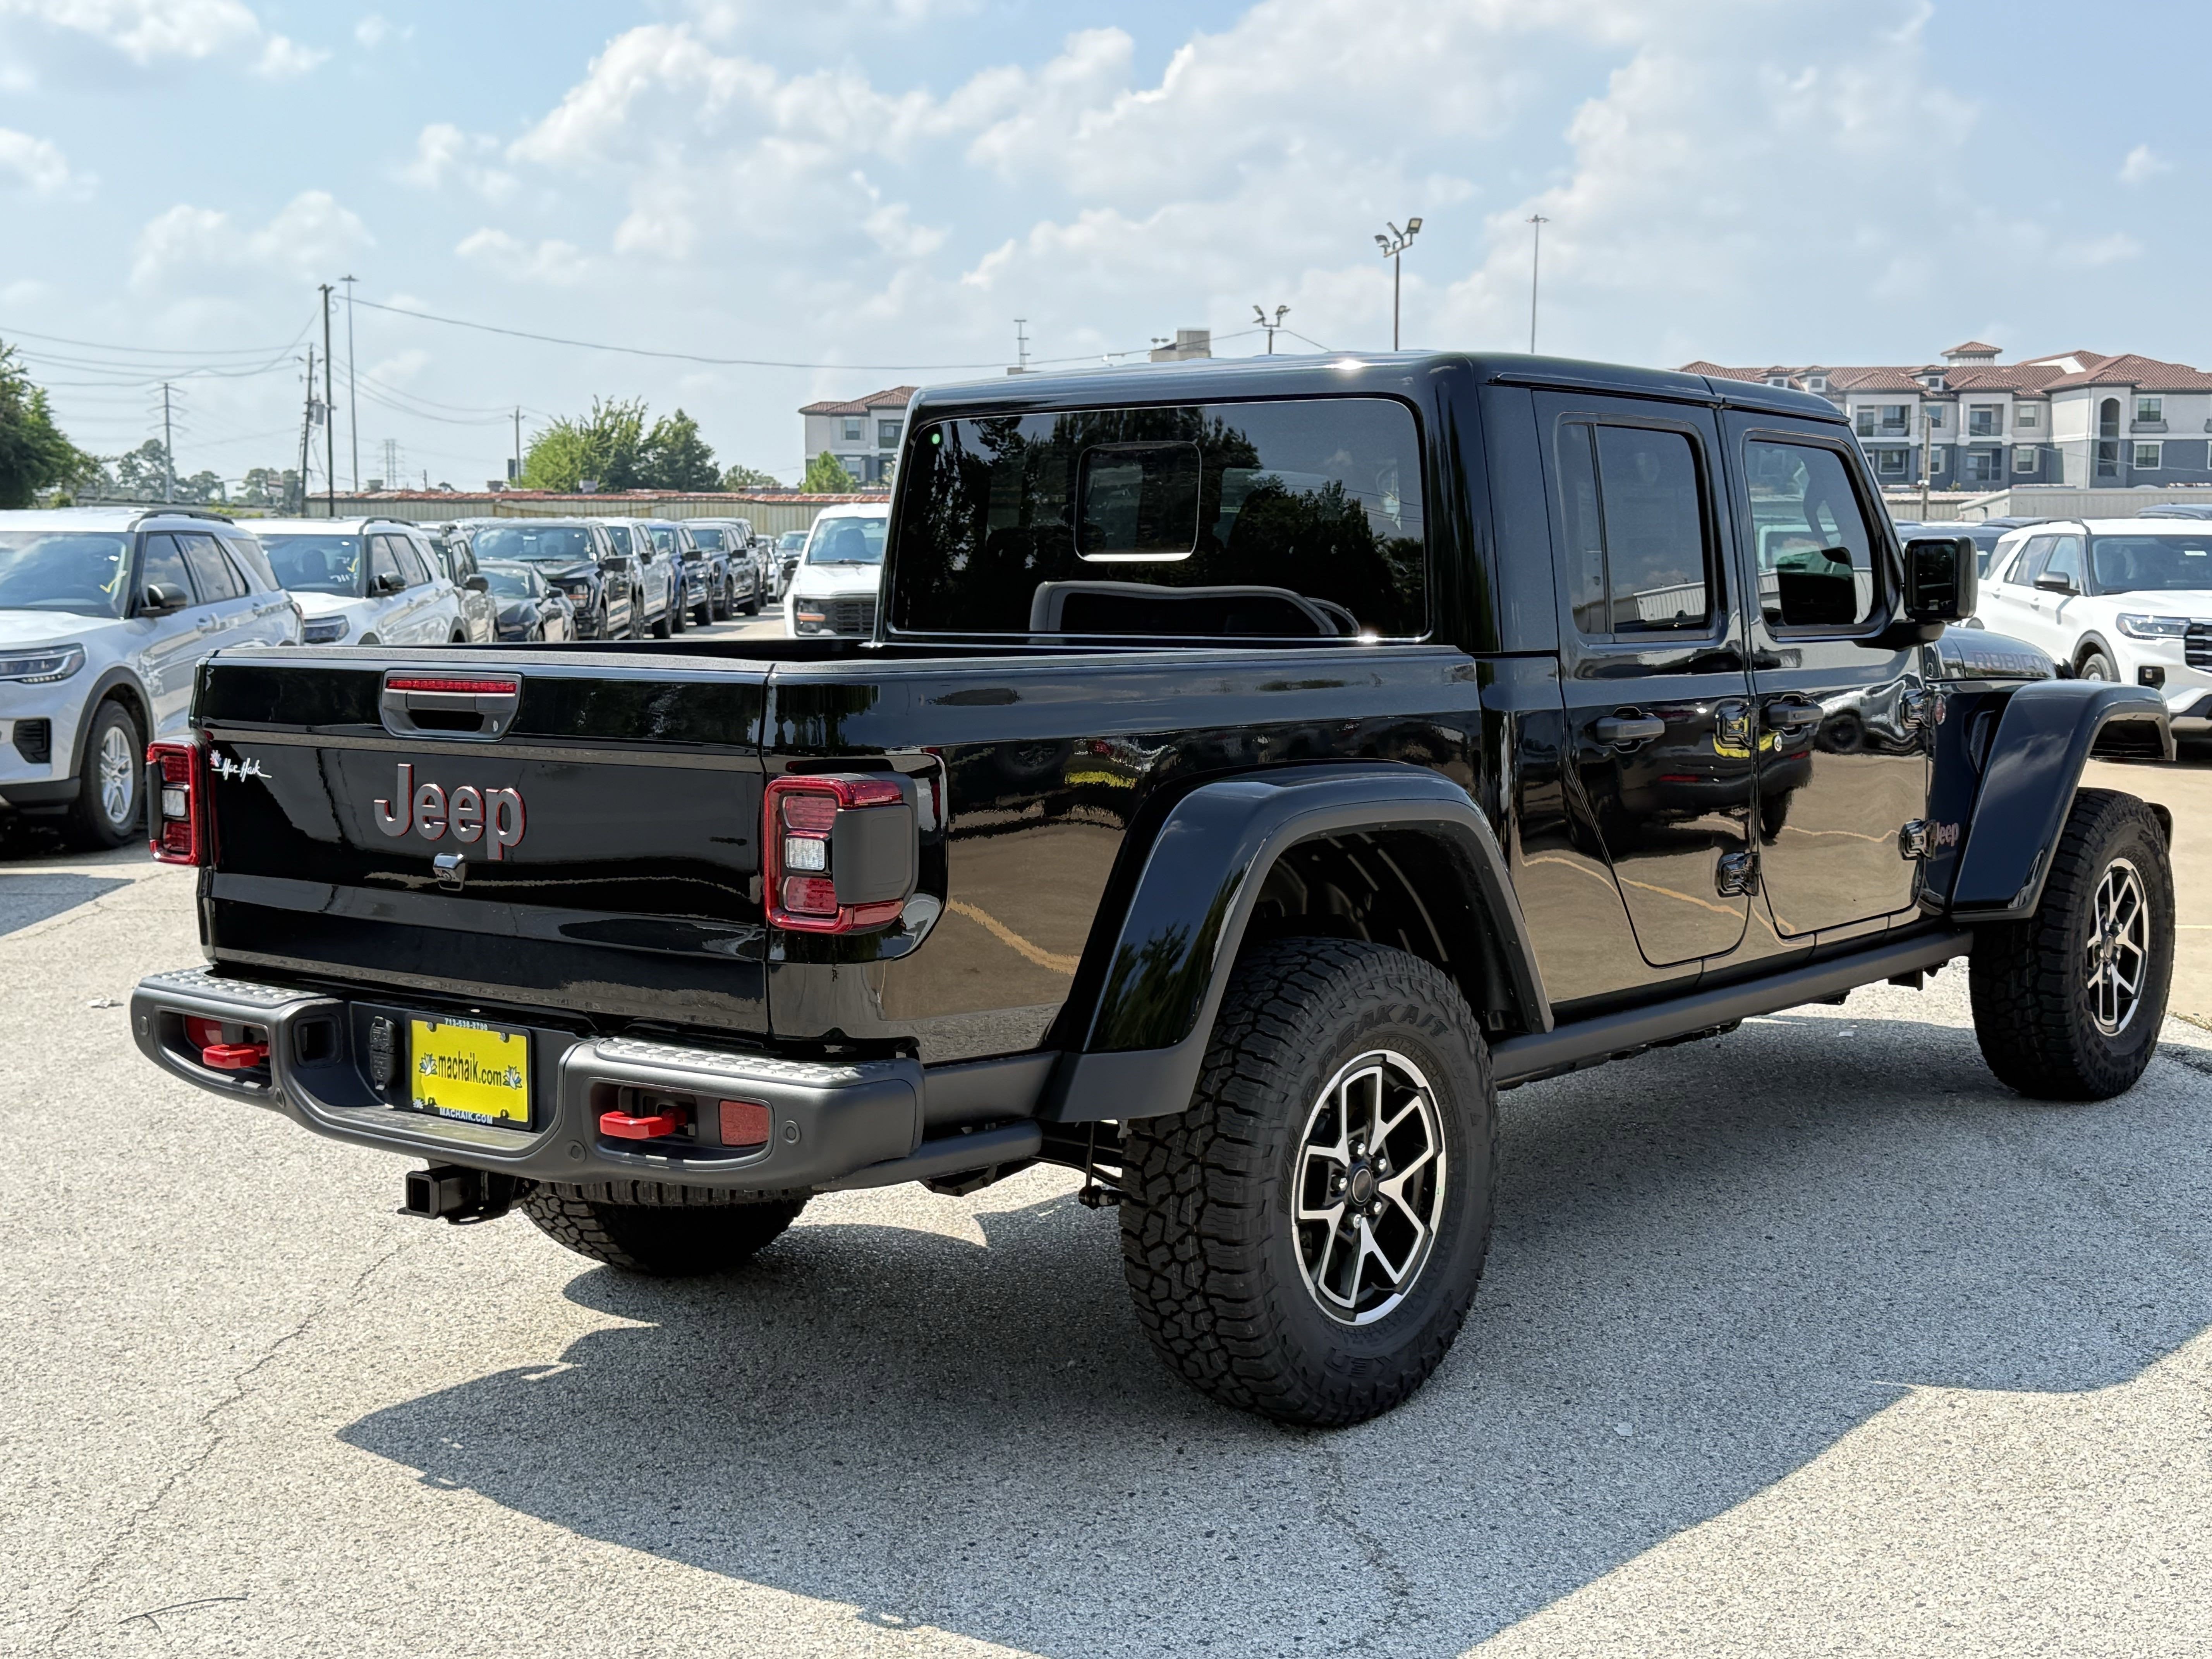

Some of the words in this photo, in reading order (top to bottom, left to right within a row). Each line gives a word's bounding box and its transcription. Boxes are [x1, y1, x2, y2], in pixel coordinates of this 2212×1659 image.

[374, 763, 527, 860] Jeep
[1934, 822, 1959, 847] Jeep
[438, 1051, 502, 1087] machaik.com
[440, 1107, 493, 1125] MACHAIK.COM
